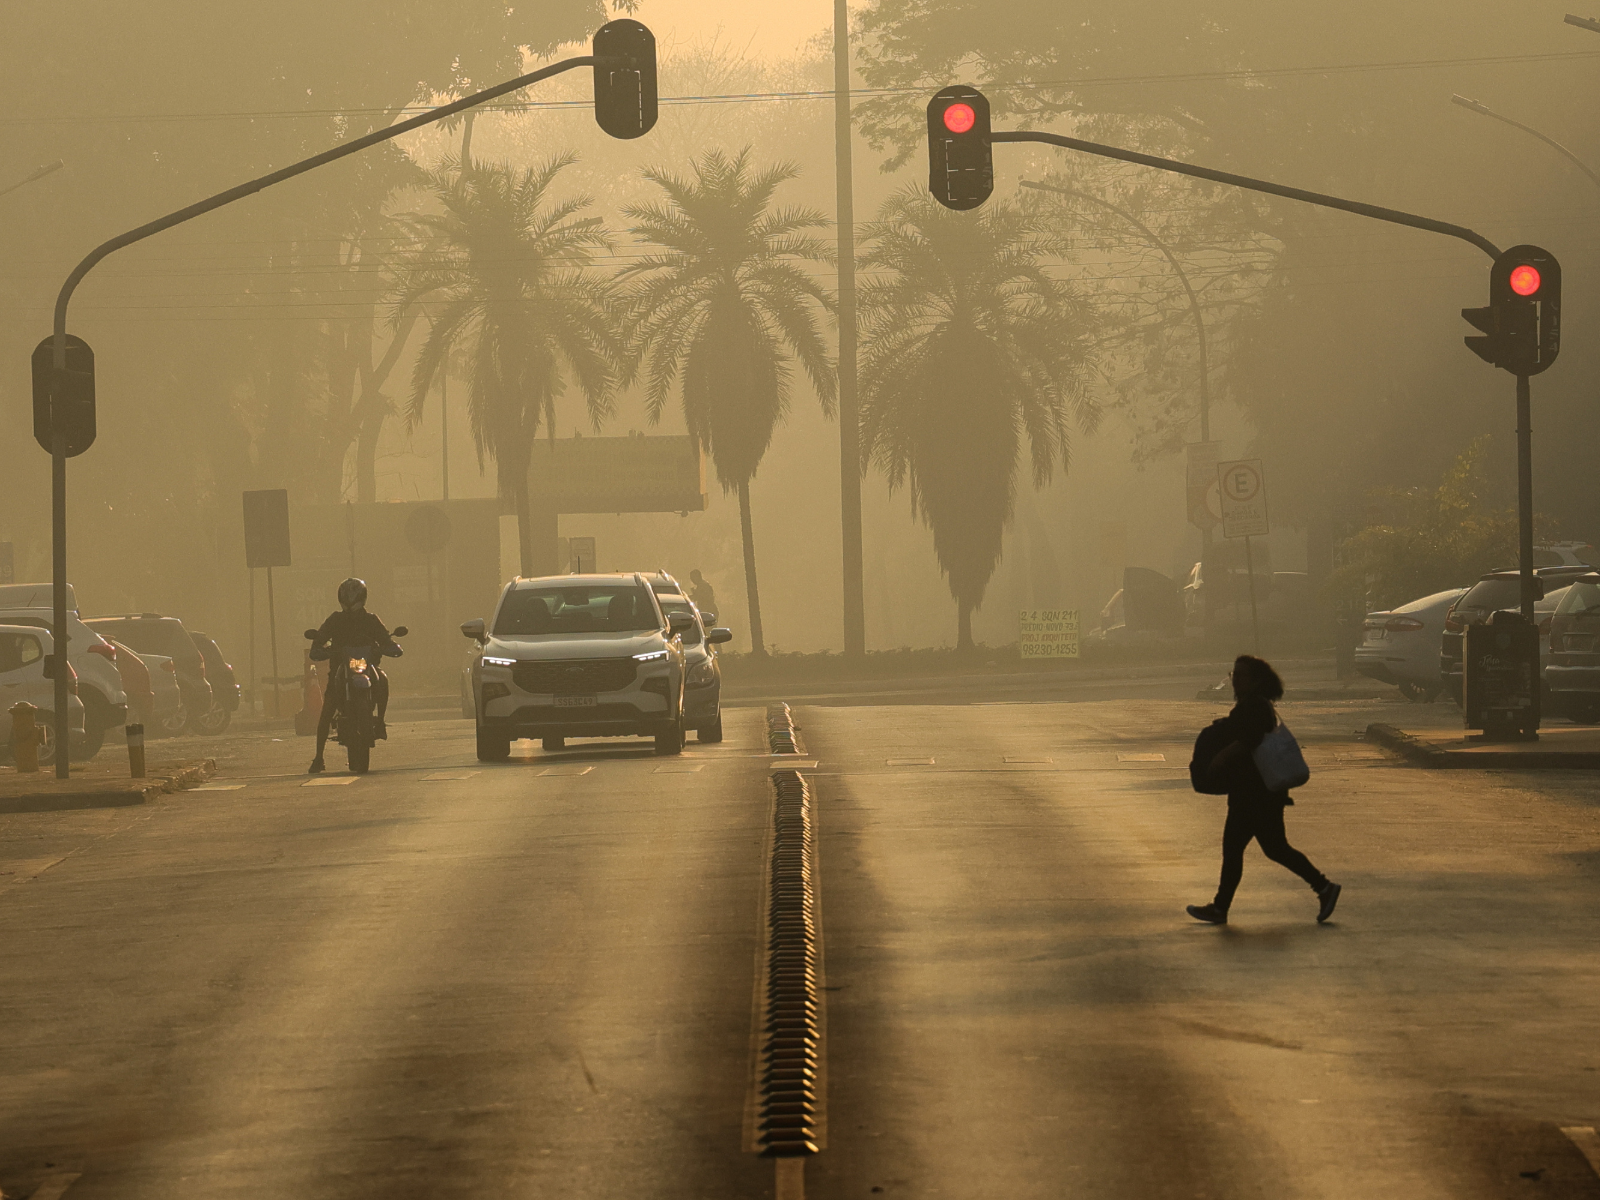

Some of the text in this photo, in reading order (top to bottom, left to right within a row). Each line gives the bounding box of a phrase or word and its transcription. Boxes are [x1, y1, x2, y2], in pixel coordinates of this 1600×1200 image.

[1234, 472, 1249, 494] E
[1042, 611, 1060, 622] SQN
[1062, 610, 1078, 620] 211
[1023, 643, 1077, 655] 98230-1255
